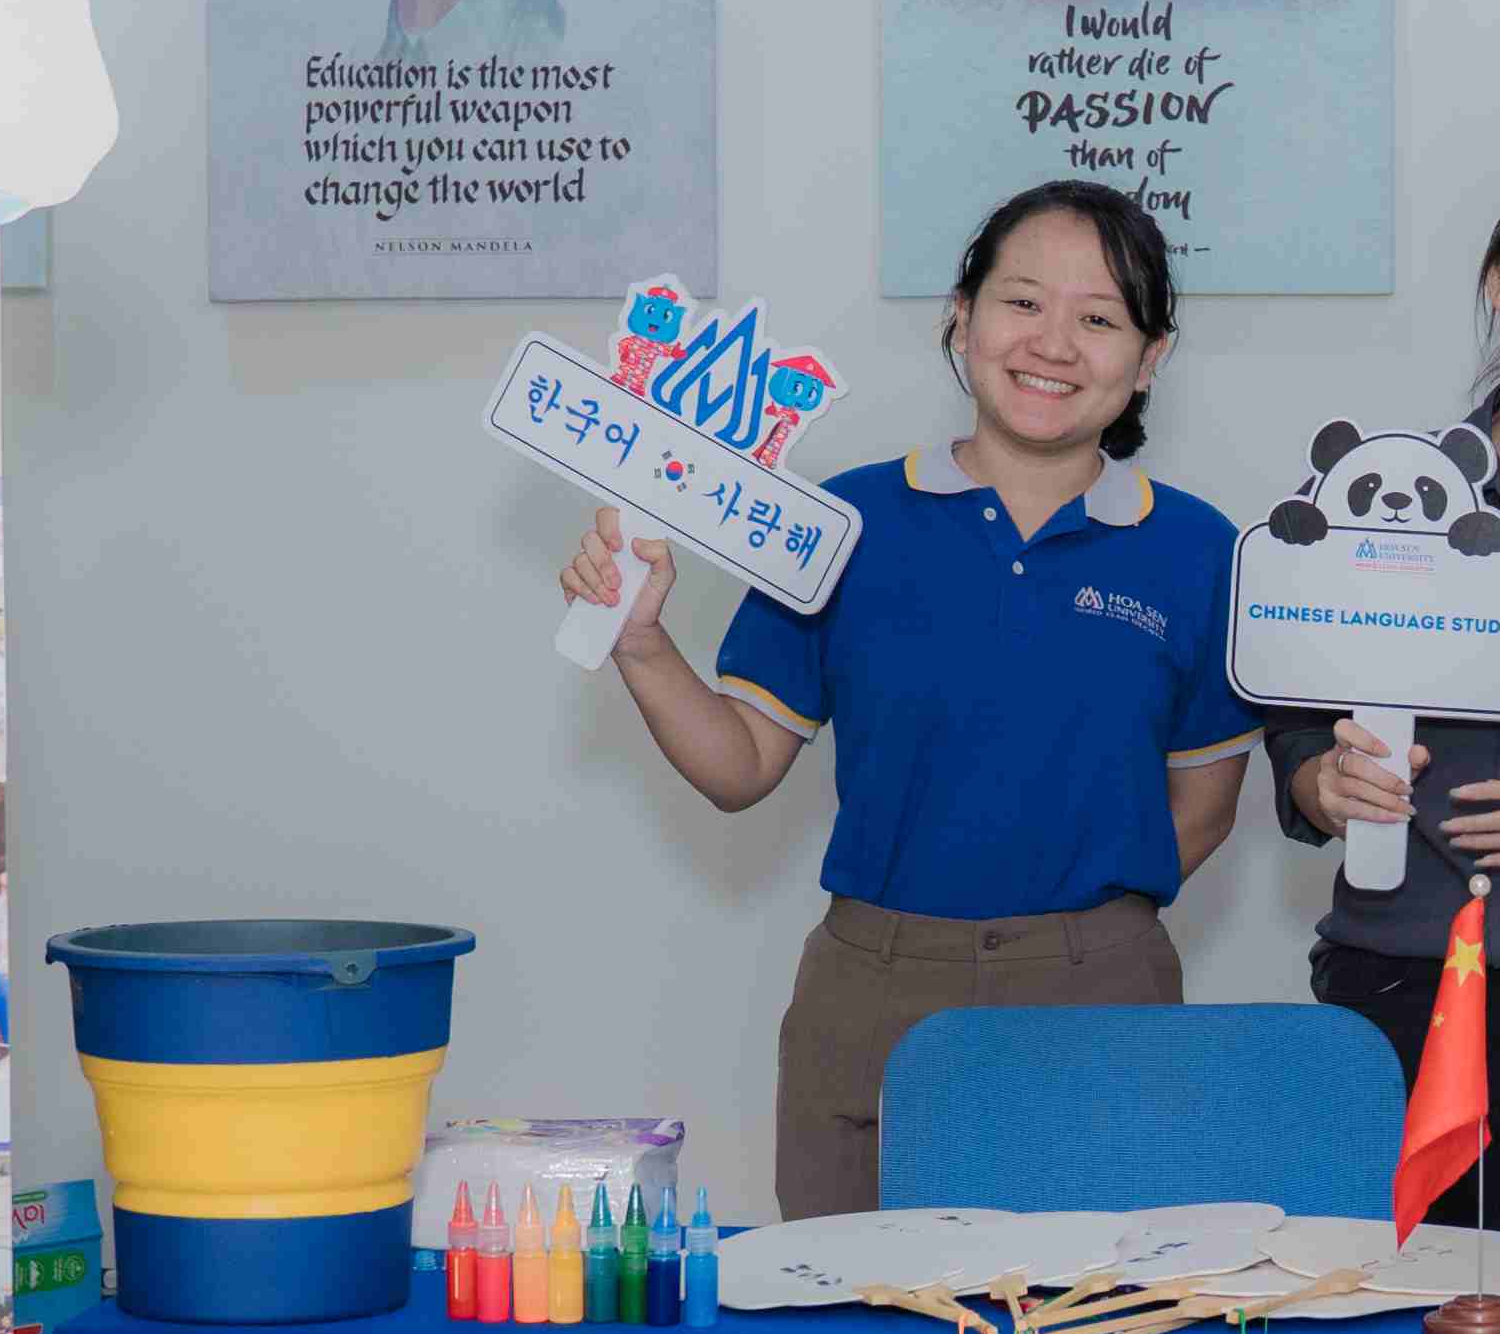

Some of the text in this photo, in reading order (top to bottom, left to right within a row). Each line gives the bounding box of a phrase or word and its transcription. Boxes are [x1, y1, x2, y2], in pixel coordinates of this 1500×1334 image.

[1065, 4, 1075, 37] I
[306, 52, 615, 89] Education is the most
[1029, 46, 1221, 83] rather die of
[306, 92, 572, 132] powerful weapon
[1016, 82, 1234, 133] PASSION
[304, 132, 630, 174] which you can use to
[1064, 138, 1182, 175] than of
[305, 168, 586, 222] change the world
[528, 374, 822, 571] 한국어 사랑해
[1108, 592, 1142, 611] HOA
[1248, 603, 1333, 625] CHINESE
[1340, 608, 1445, 632] LANGUAGE
